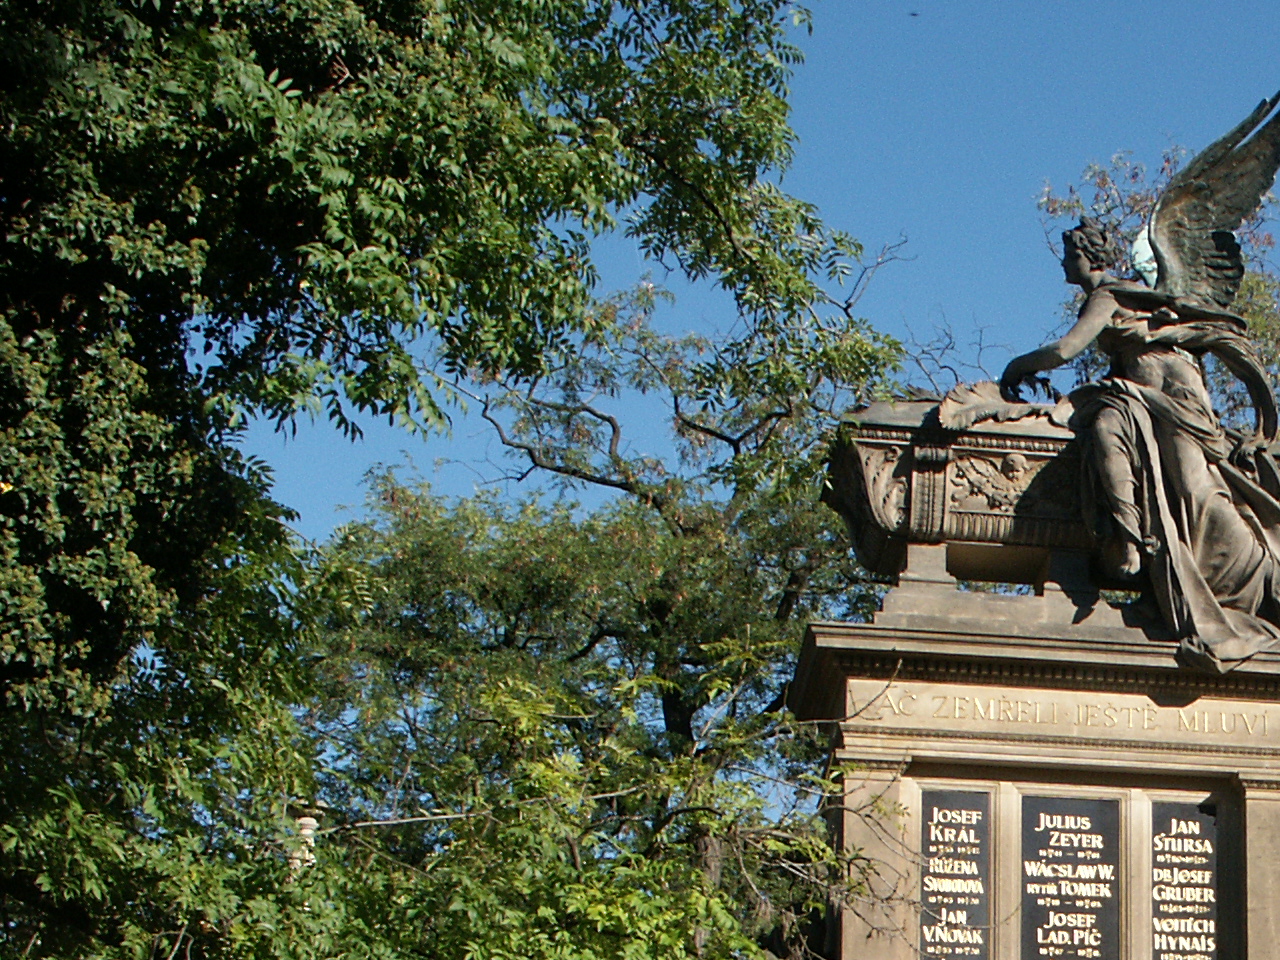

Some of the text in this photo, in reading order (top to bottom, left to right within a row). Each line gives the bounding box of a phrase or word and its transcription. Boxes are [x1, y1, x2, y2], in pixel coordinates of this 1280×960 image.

[877, 689, 1269, 737] AČ ZEMŘELI JEŠTĚ MLUVÍ
[928, 807, 983, 825] JOSEF
[1034, 812, 1092, 832] JULIUS
[929, 825, 981, 844] KRÁL
[1170, 818, 1200, 836] JAN
[1049, 831, 1104, 849] ZEYER
[1153, 832, 1213, 854] ŠTURSA
[1024, 859, 1115, 880] WÁCSLAW W.
[1171, 867, 1213, 886] JOSEF
[923, 875, 985, 894] SVOBODOVÁ
[1059, 880, 1112, 898] TOMEK
[1152, 884, 1216, 903] GRUBER
[938, 908, 967, 927] JAN
[1043, 910, 1097, 929] JOSEF
[1037, 927, 1102, 946] LAD. PÍČ
